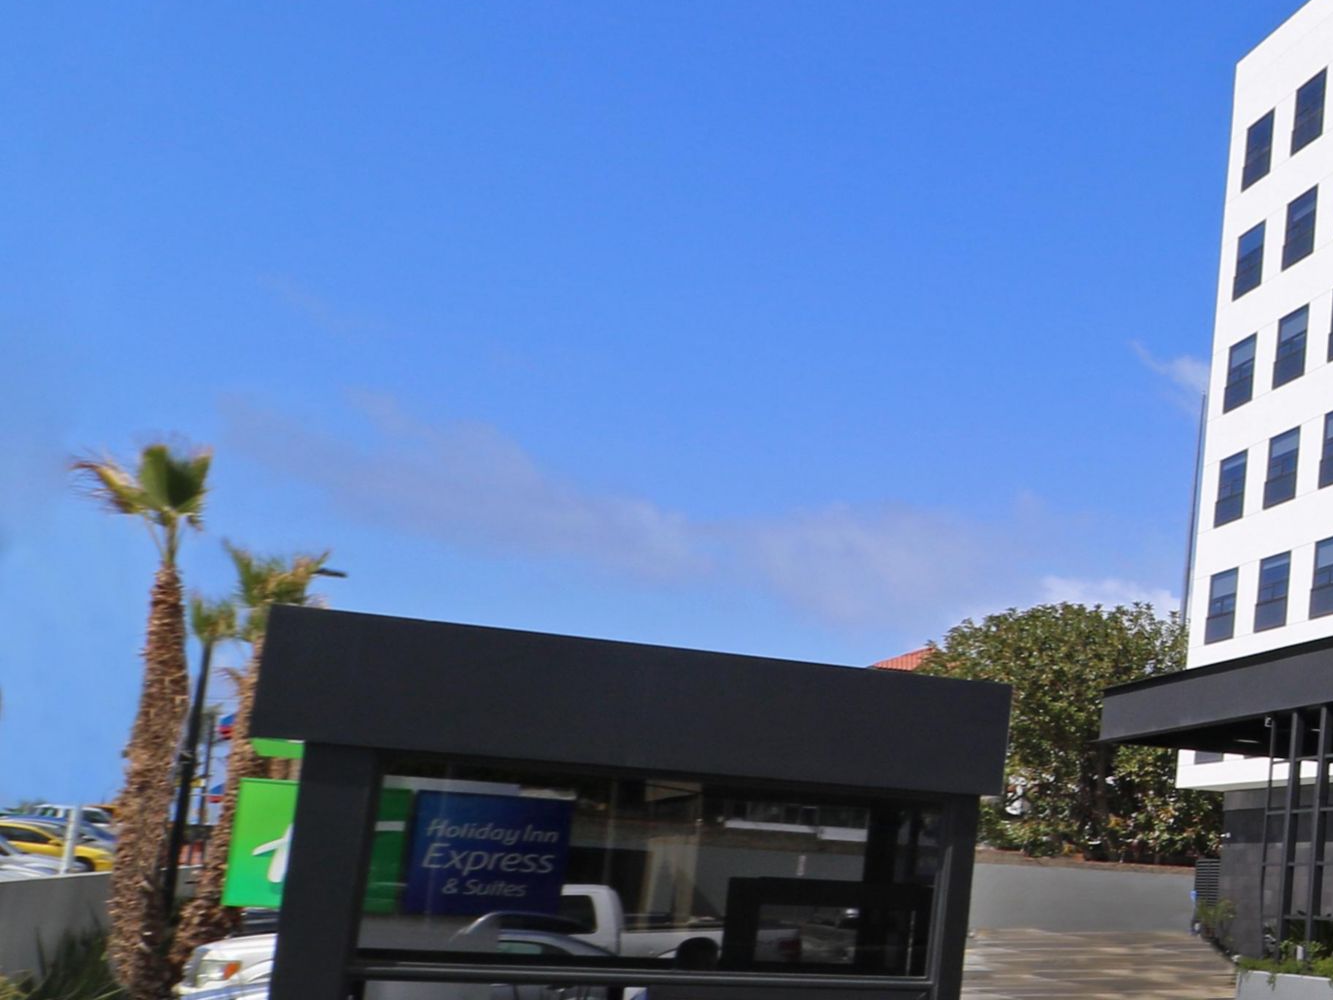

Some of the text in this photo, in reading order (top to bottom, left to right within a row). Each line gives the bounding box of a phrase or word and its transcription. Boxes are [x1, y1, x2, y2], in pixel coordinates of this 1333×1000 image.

[426, 818, 560, 846] Holiday Inn
[421, 843, 556, 876] Express
[441, 878, 528, 897] & Suites
